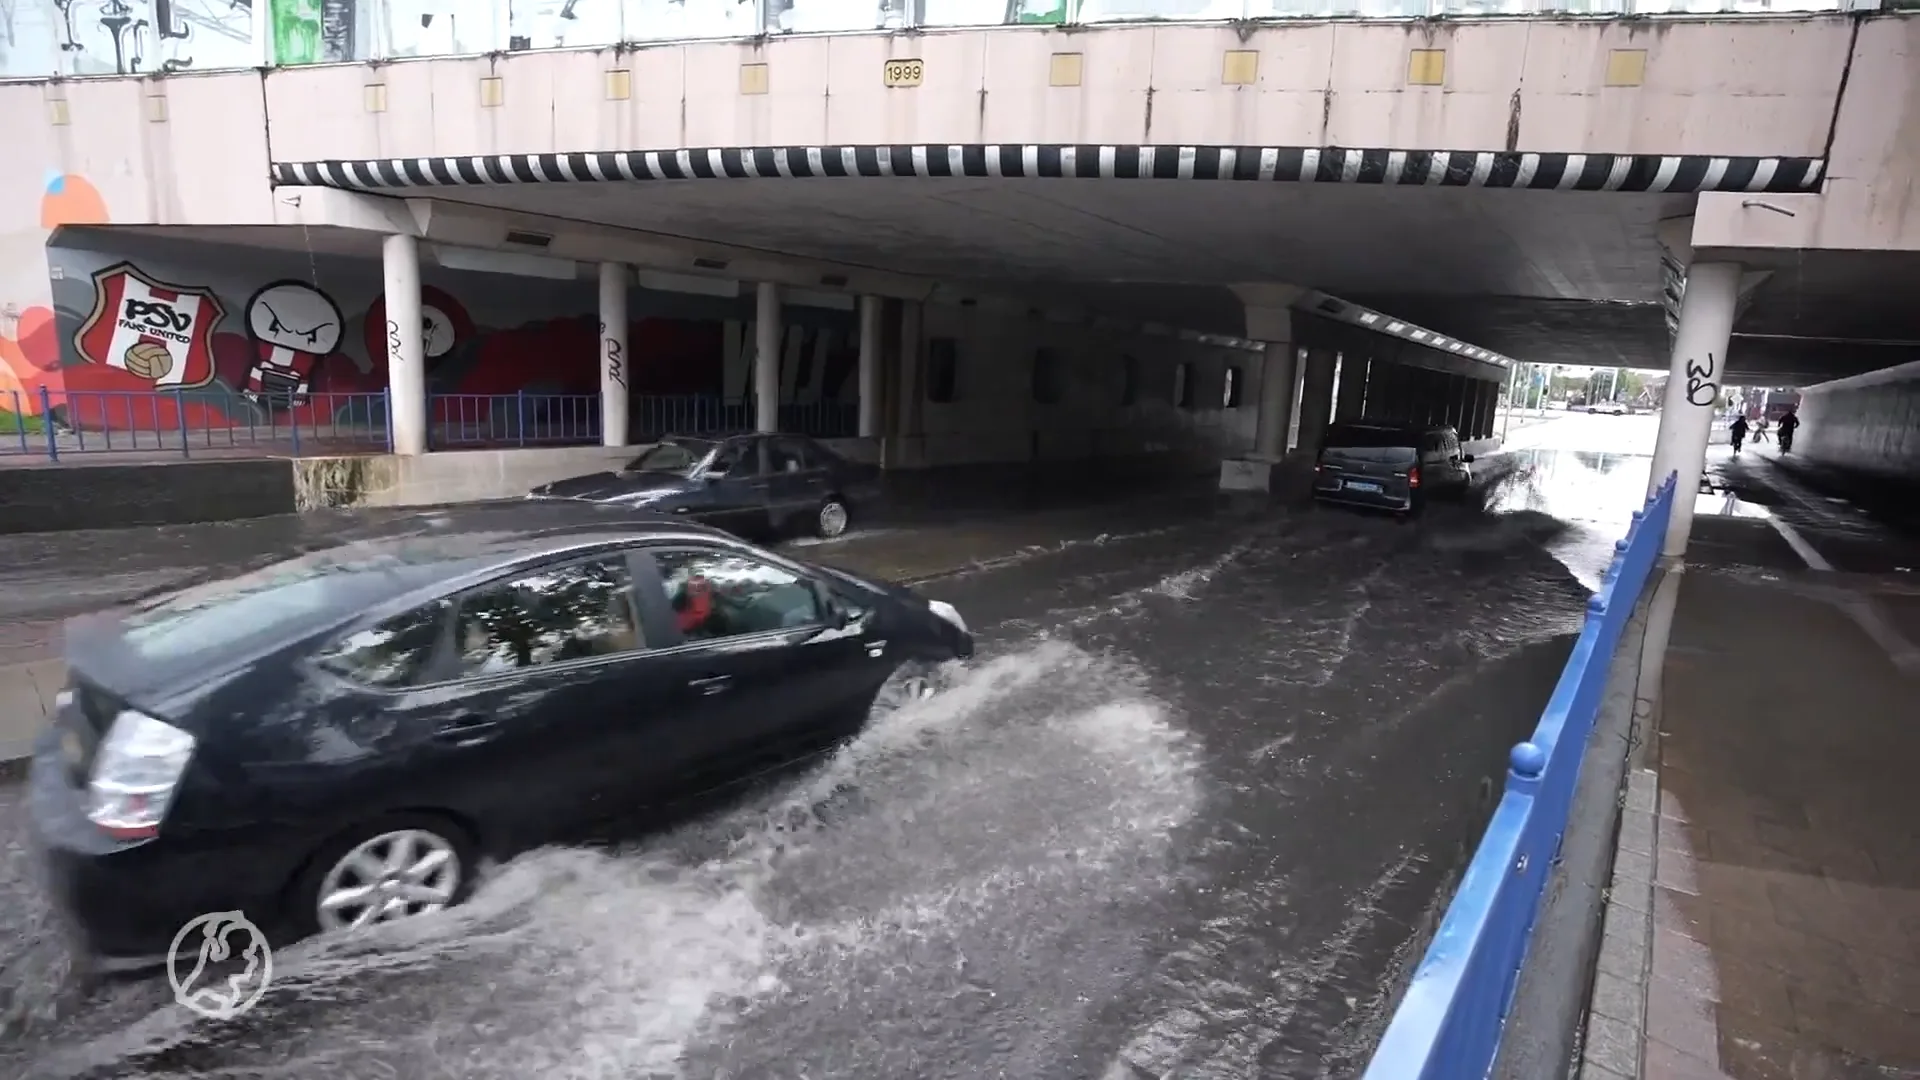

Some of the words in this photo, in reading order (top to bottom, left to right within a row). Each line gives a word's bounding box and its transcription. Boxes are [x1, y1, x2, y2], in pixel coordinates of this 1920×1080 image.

[887, 65, 921, 81] 1999
[126, 298, 192, 332] PSV
[118, 319, 148, 333] FANS
[149, 328, 191, 344] UNITED
